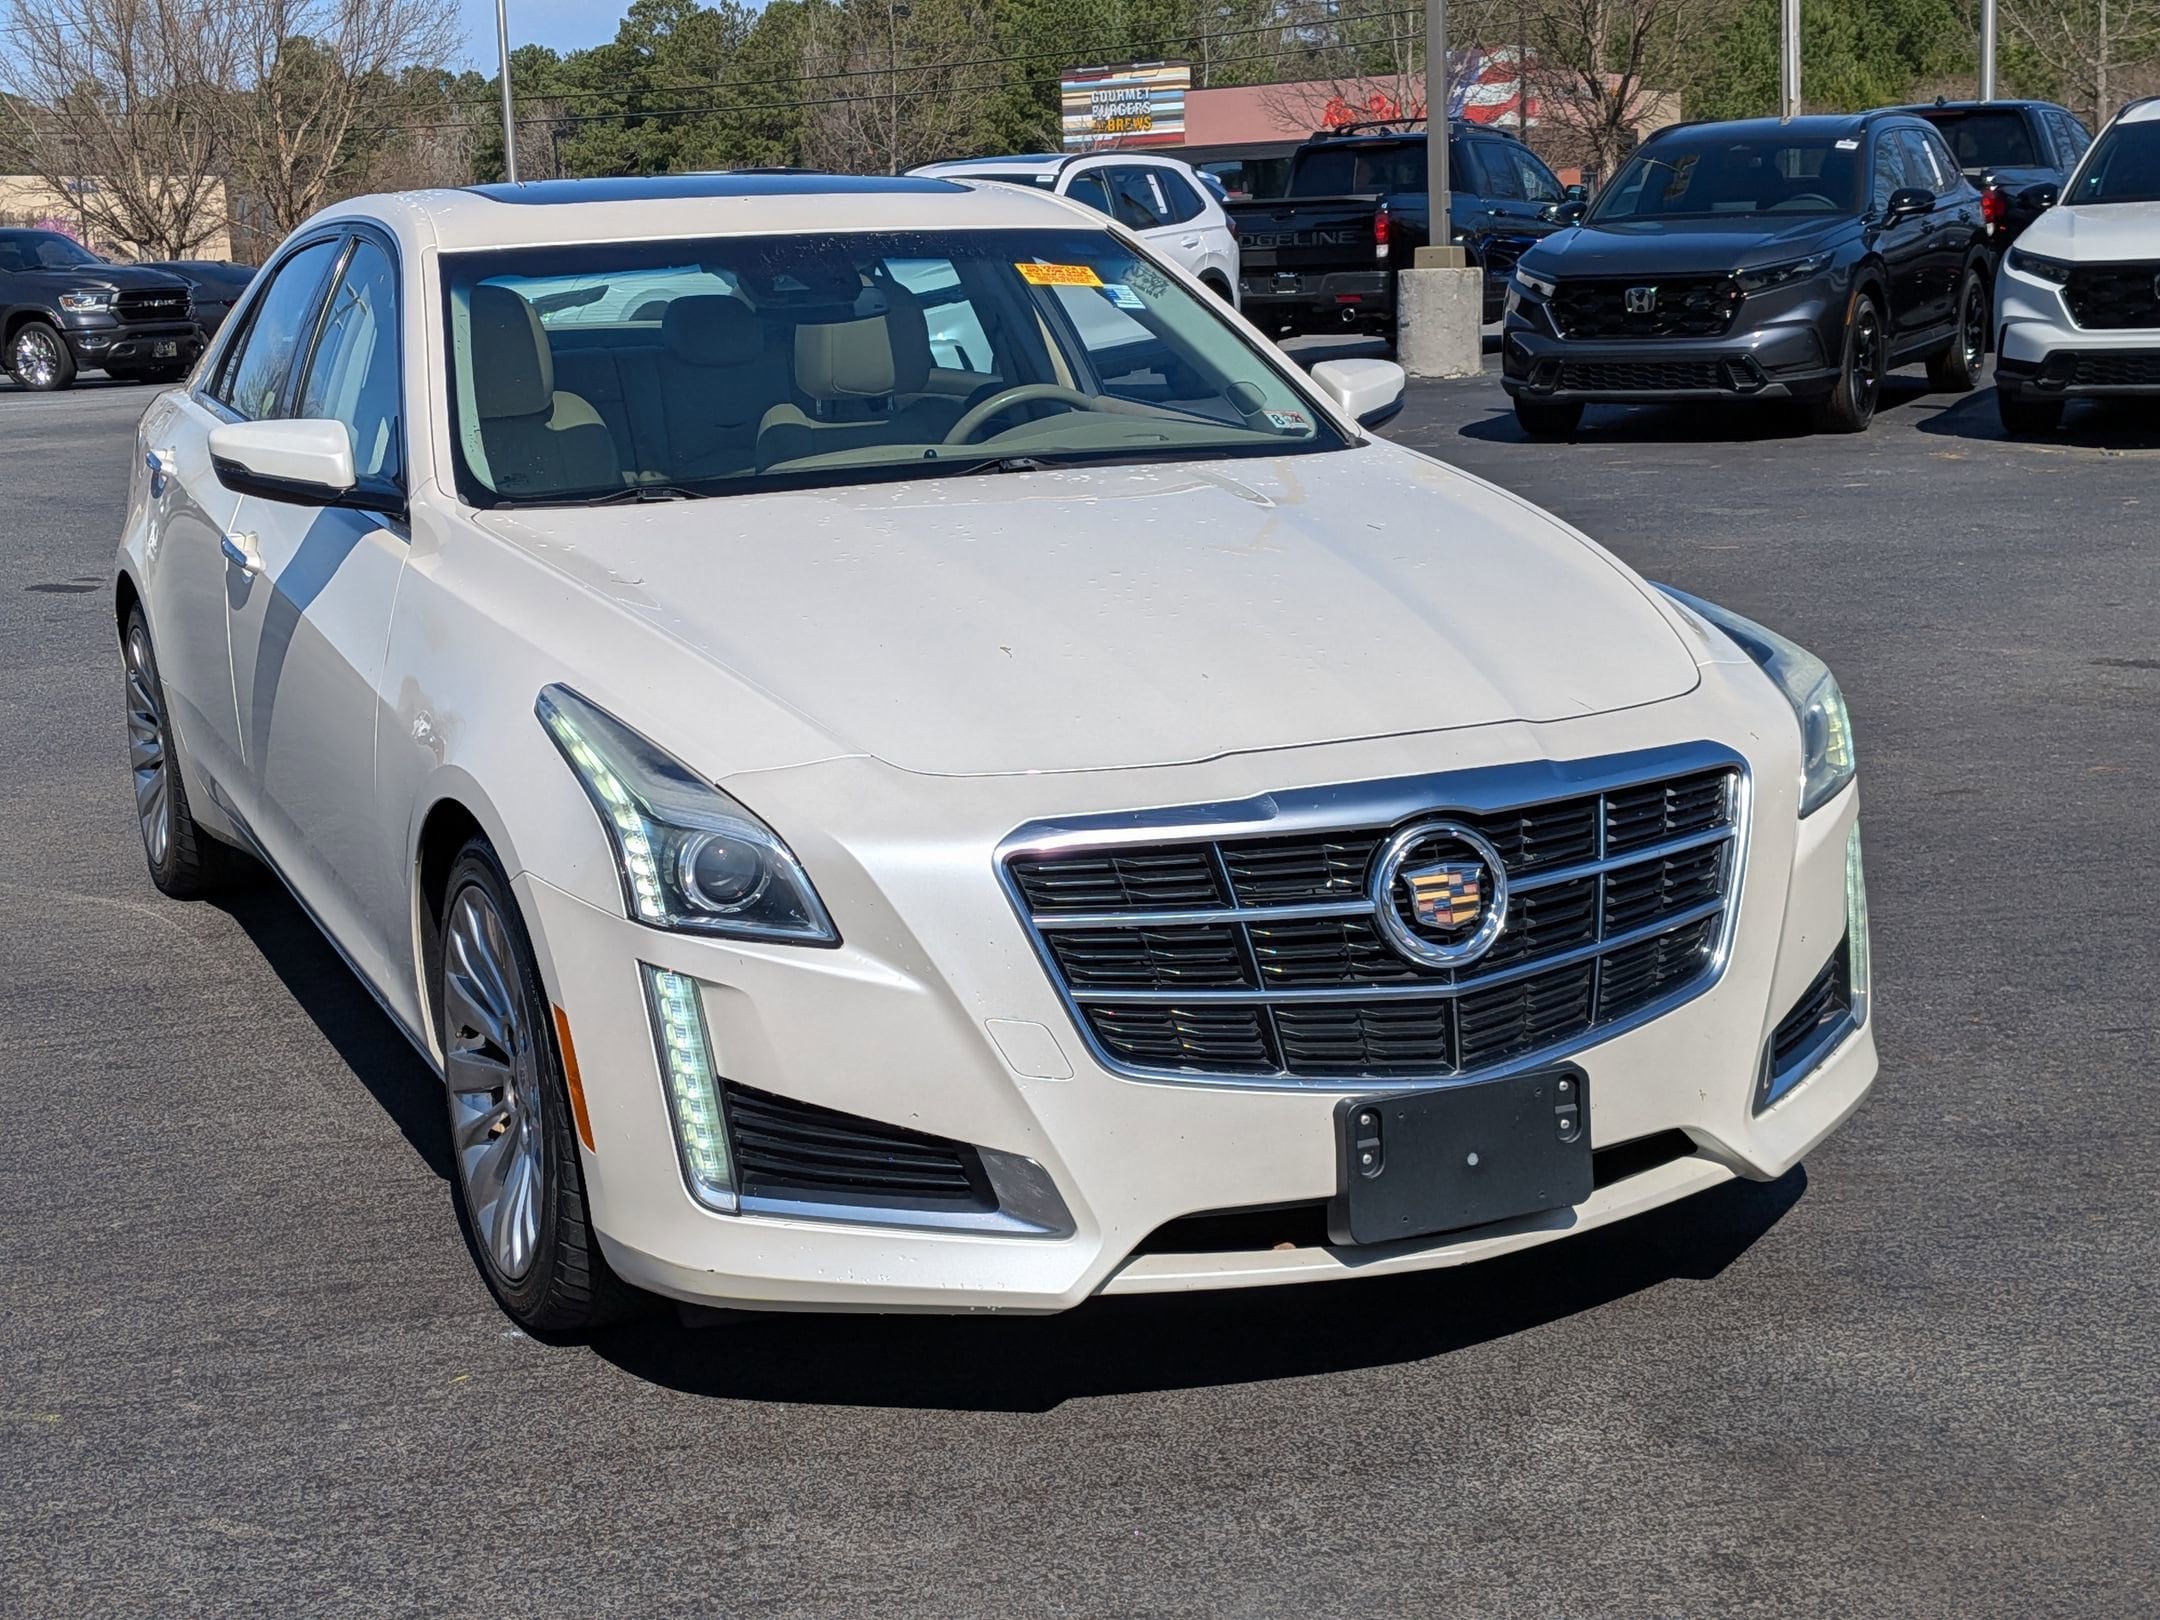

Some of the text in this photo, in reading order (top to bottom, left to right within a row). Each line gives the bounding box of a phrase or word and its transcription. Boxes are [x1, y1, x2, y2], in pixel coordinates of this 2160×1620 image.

[1092, 87, 1150, 103] GOURMET
[1092, 101, 1151, 118] BURGERS
[1107, 116, 1152, 132] BREWS
